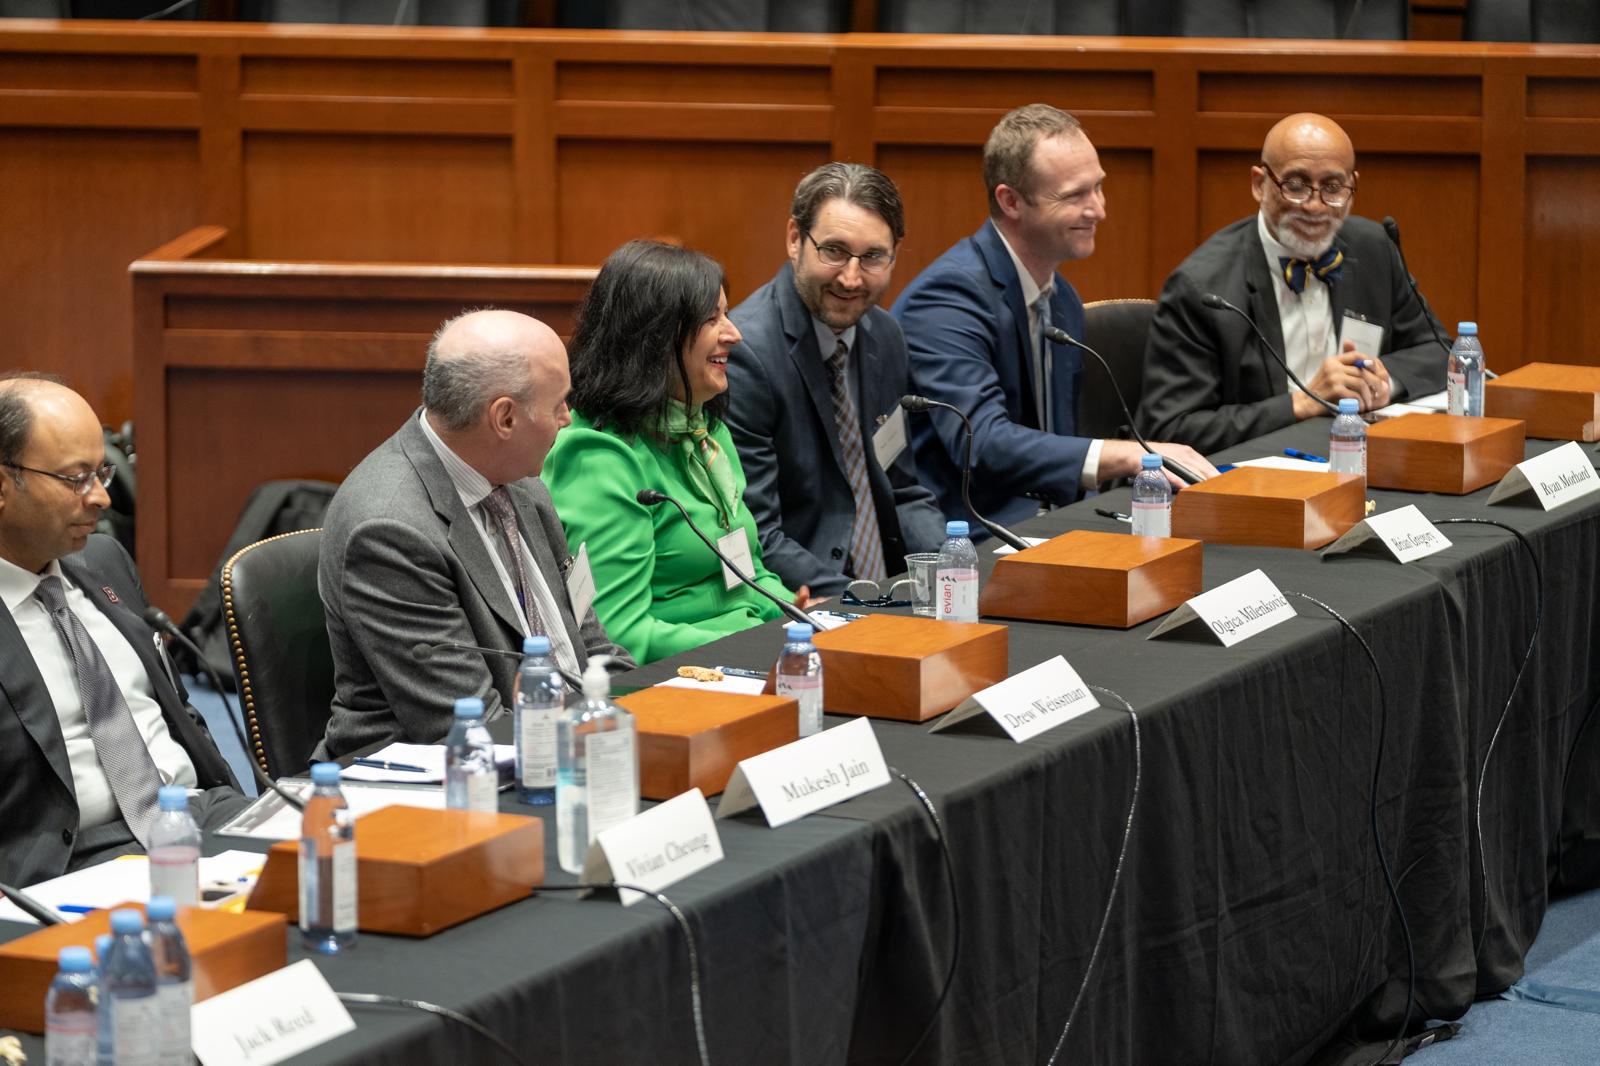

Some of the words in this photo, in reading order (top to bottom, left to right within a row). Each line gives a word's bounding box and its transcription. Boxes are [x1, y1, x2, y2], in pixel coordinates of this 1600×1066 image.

[1541, 481, 1563, 499] Ryan
[1558, 464, 1591, 489] Morhard
[943, 583, 953, 614] evian
[1211, 615, 1245, 636] Olgica
[1237, 593, 1288, 623] Milenkovic
[1004, 708, 1038, 729] Drew
[1031, 687, 1087, 715] Weissman
[781, 768, 841, 802] Mukesh
[838, 758, 870, 787] Jain
